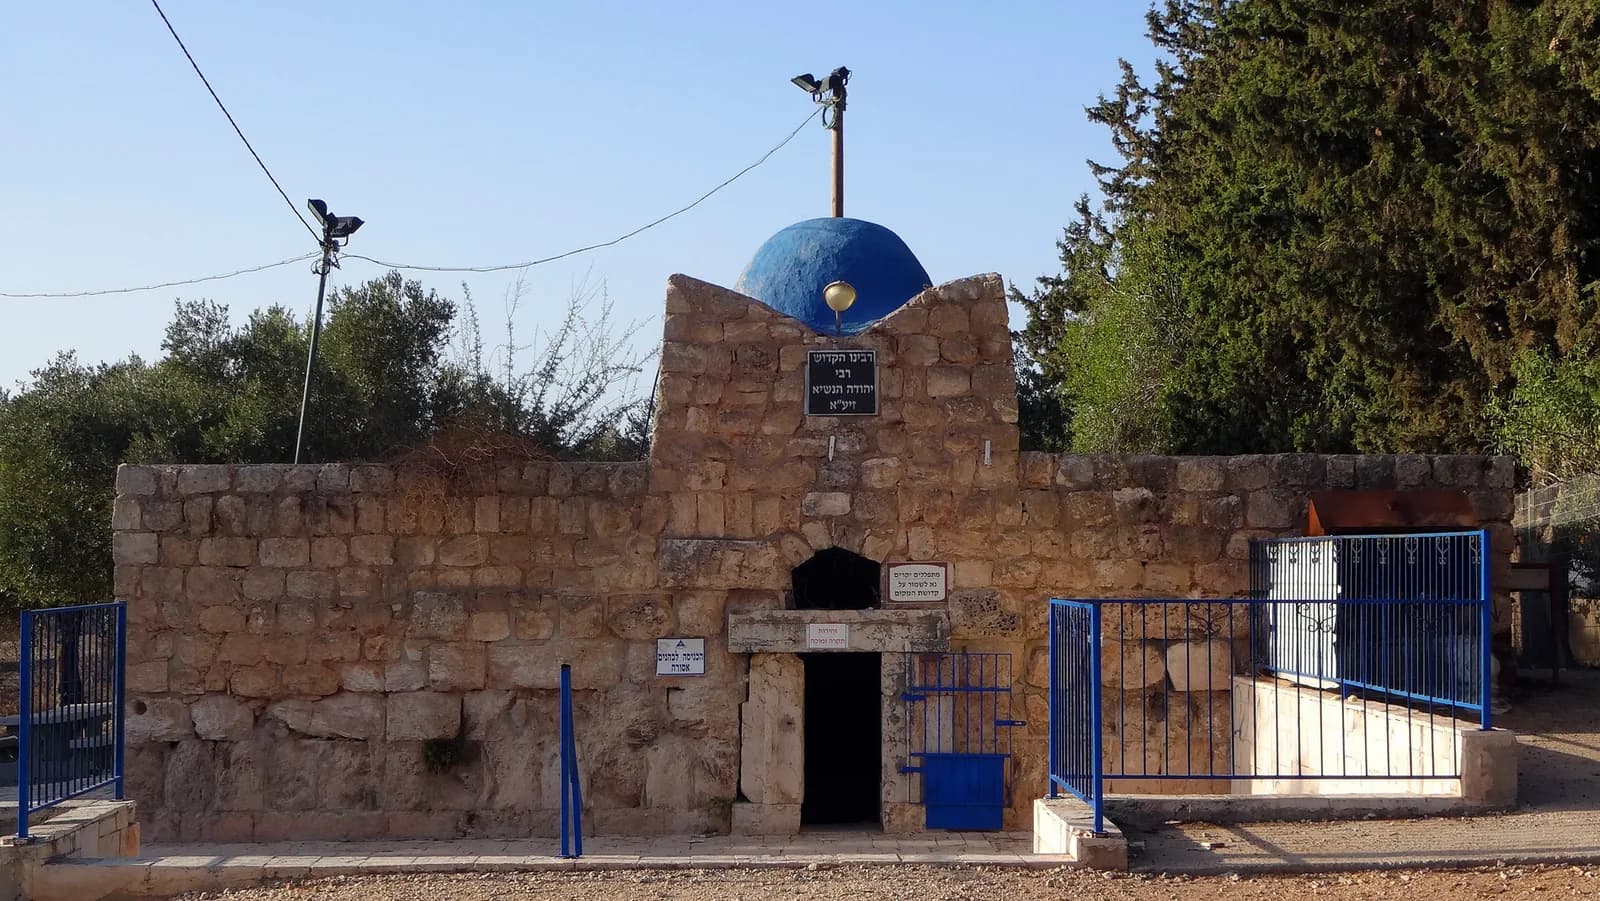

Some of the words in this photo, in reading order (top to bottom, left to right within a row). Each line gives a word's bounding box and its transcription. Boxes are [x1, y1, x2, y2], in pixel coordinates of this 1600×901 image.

[813, 353, 846, 365] הקדוש
[849, 353, 873, 362] רבינו
[835, 369, 851, 378] רבי
[812, 384, 843, 394] הנשיא
[846, 384, 874, 394] יהודה
[658, 650, 679, 661] לכהנים
[682, 652, 704, 661] הכניסה
[671, 663, 690, 672] אסורה
